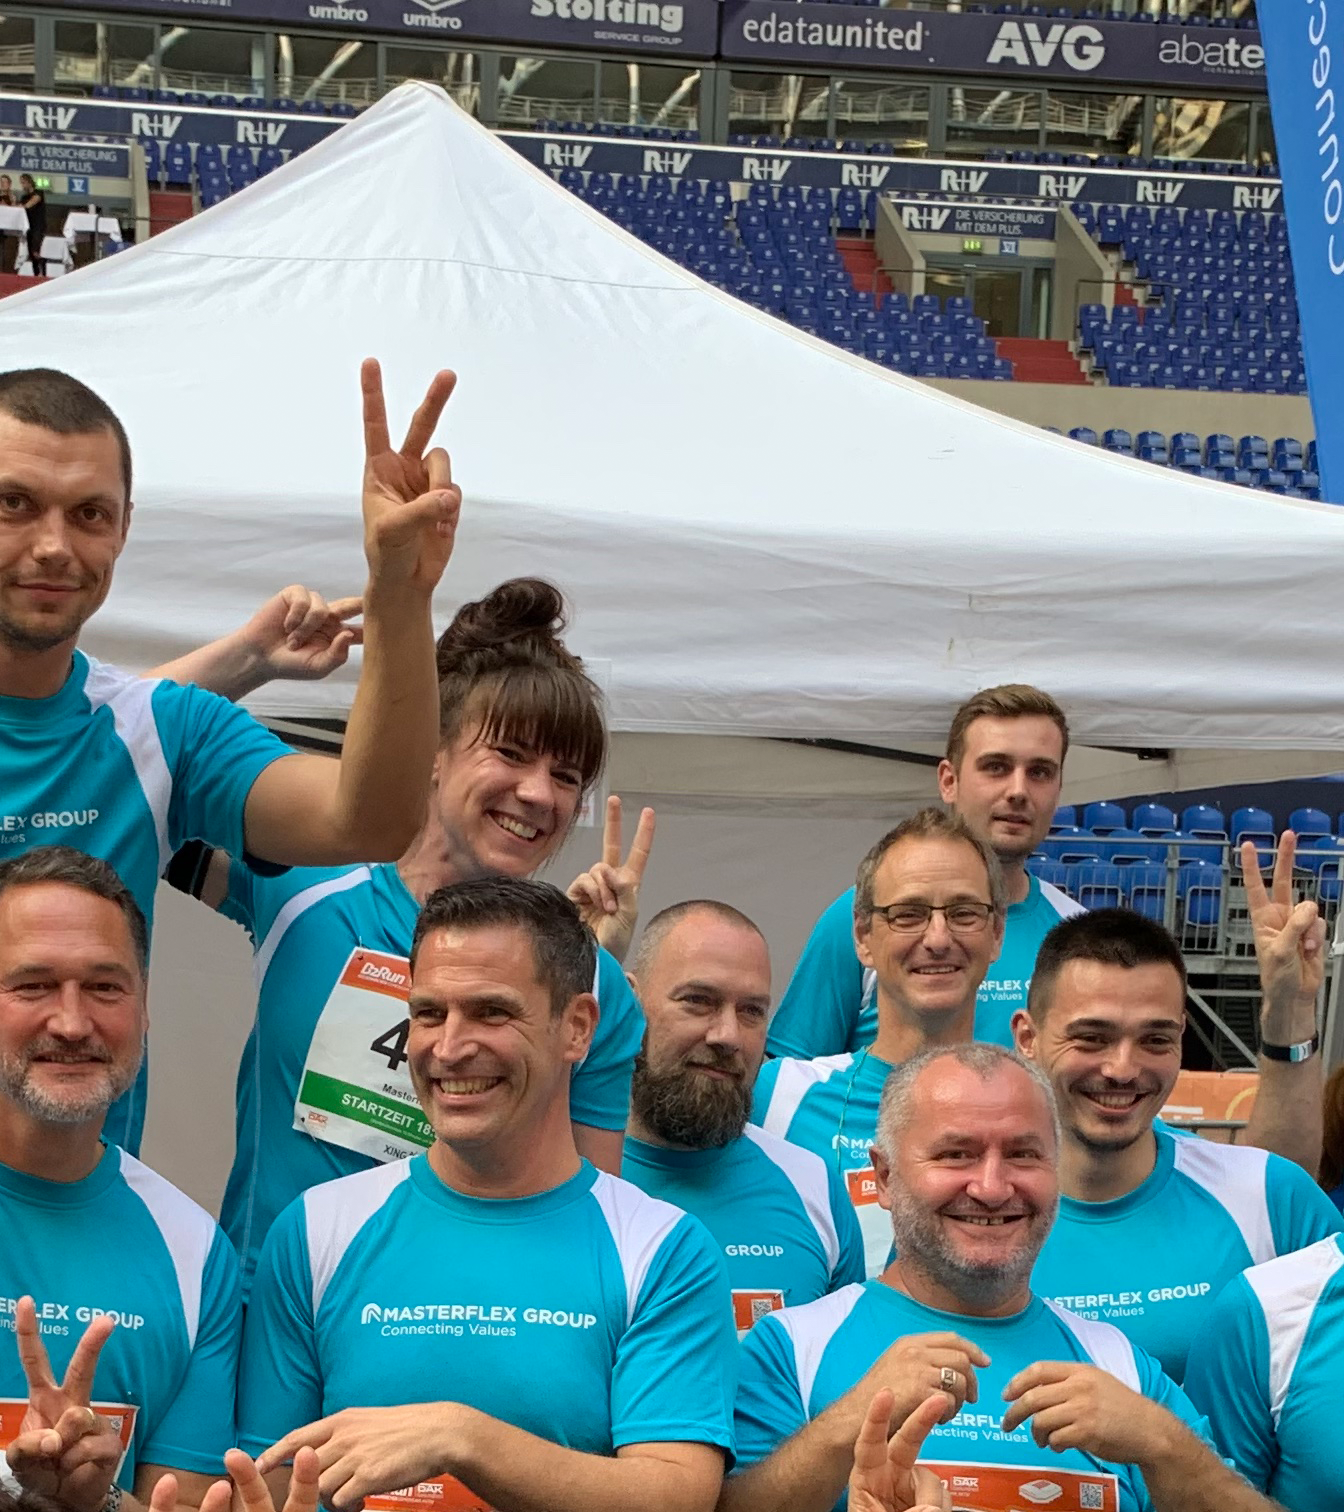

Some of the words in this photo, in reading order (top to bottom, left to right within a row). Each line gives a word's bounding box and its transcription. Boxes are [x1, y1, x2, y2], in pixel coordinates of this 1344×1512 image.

[309, 5, 368, 21] umbro
[403, 12, 461, 29] umbro
[593, 31, 640, 42] SERVICE
[642, 35, 682, 45] GROUP
[743, 13, 923, 52] edataunited
[987, 21, 1105, 71] AVG
[132, 112, 182, 138] R+V
[21, 146, 36, 159] DIE
[544, 143, 593, 168] R+V
[21, 158, 38, 171] MIT
[43, 159, 68, 172] DEM
[742, 157, 792, 182] R+V
[940, 169, 989, 193] R+V
[1136, 180, 1185, 204] R+V
[902, 206, 951, 231] R+V
[956, 209, 970, 221] DIE
[956, 221, 973, 233] MIT
[976, 222, 997, 234] DEM
[31, 808, 99, 829] GROUP
[725, 1244, 785, 1258] GROUP
[1148, 1283, 1211, 1302] GROUP
[383, 1305, 516, 1323] MASTERFLEX
[522, 1307, 597, 1329] GROUP
[381, 1323, 464, 1338] Connecting
[468, 1322, 516, 1337] Values
